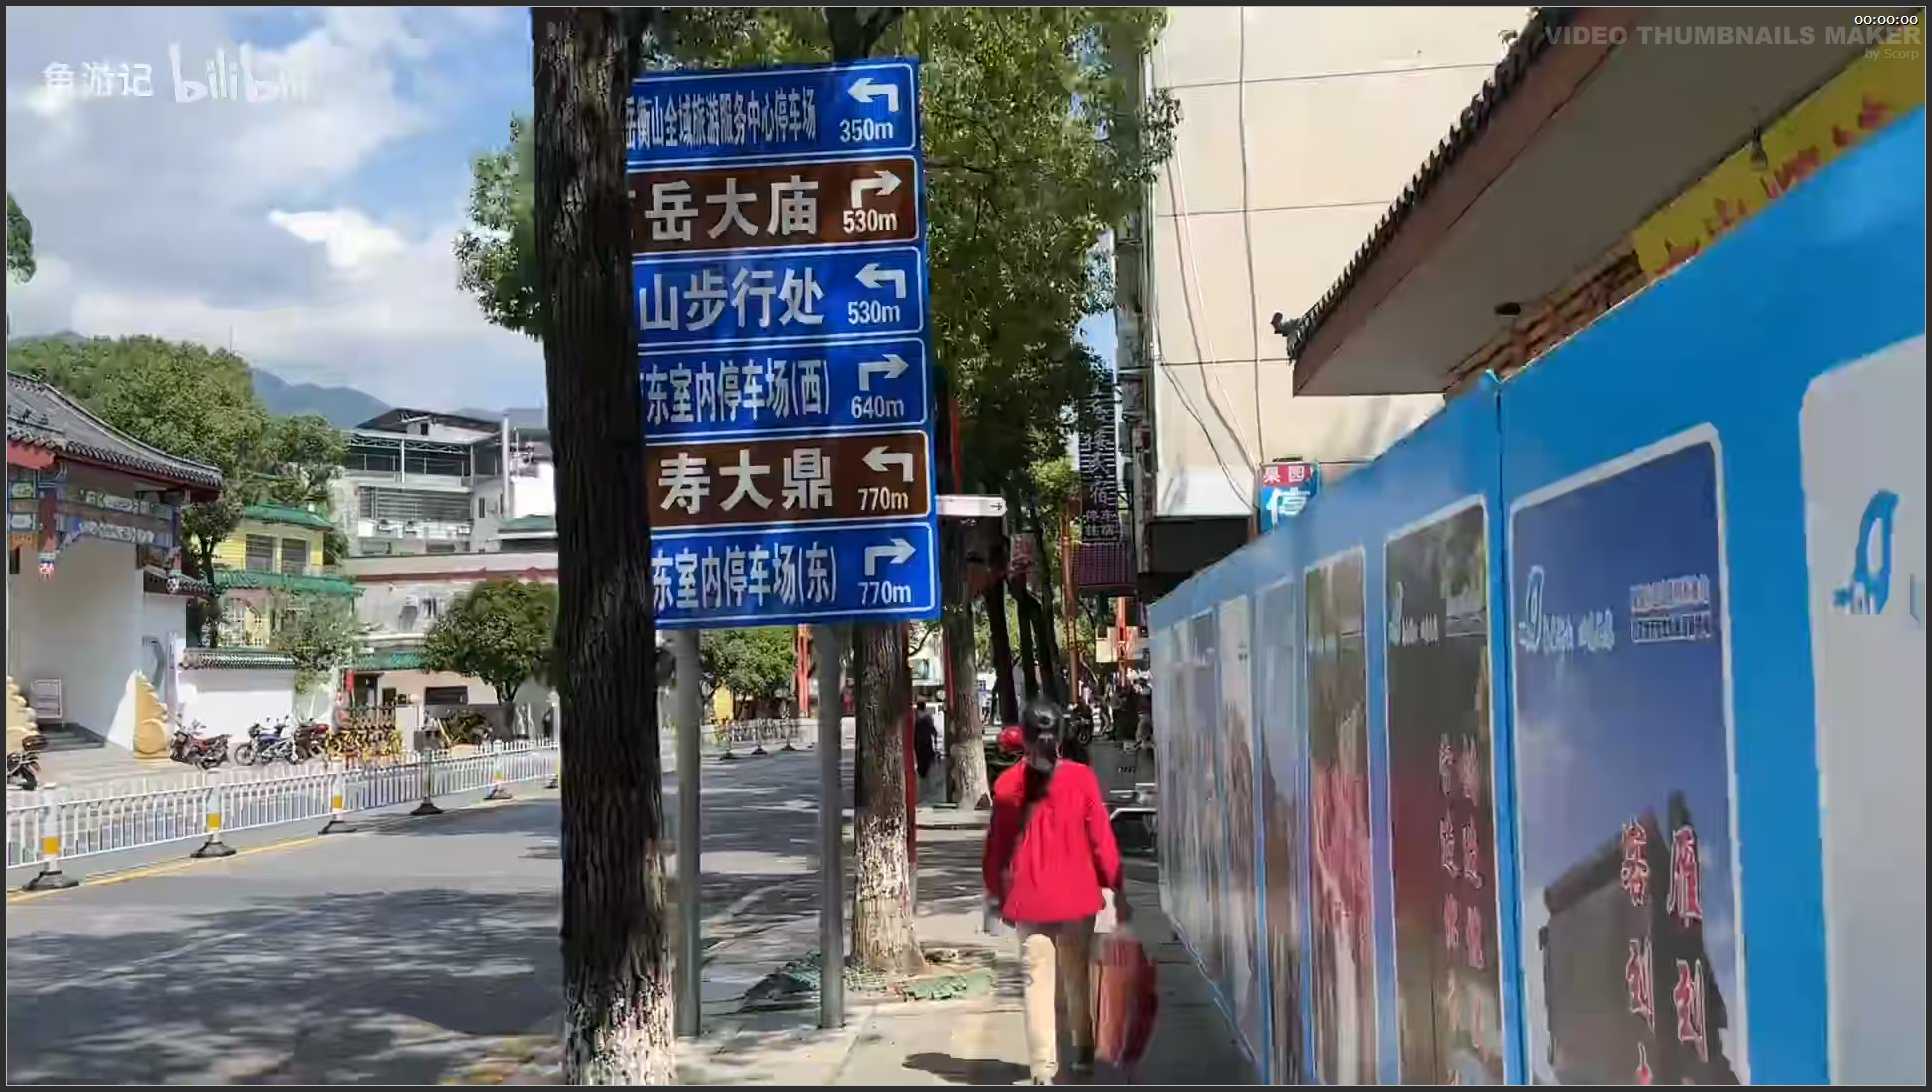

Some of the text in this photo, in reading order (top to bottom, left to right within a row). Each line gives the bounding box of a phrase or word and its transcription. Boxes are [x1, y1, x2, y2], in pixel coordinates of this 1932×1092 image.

[839, 118, 894, 142] 350m
[628, 174, 898, 242] 岳大庙 530m
[638, 266, 901, 331] 山步行处 530m
[640, 356, 905, 425] 东室内停车场(西) 640m
[658, 448, 909, 515] 寿大鼎 770m
[857, 579, 912, 605] 770m
